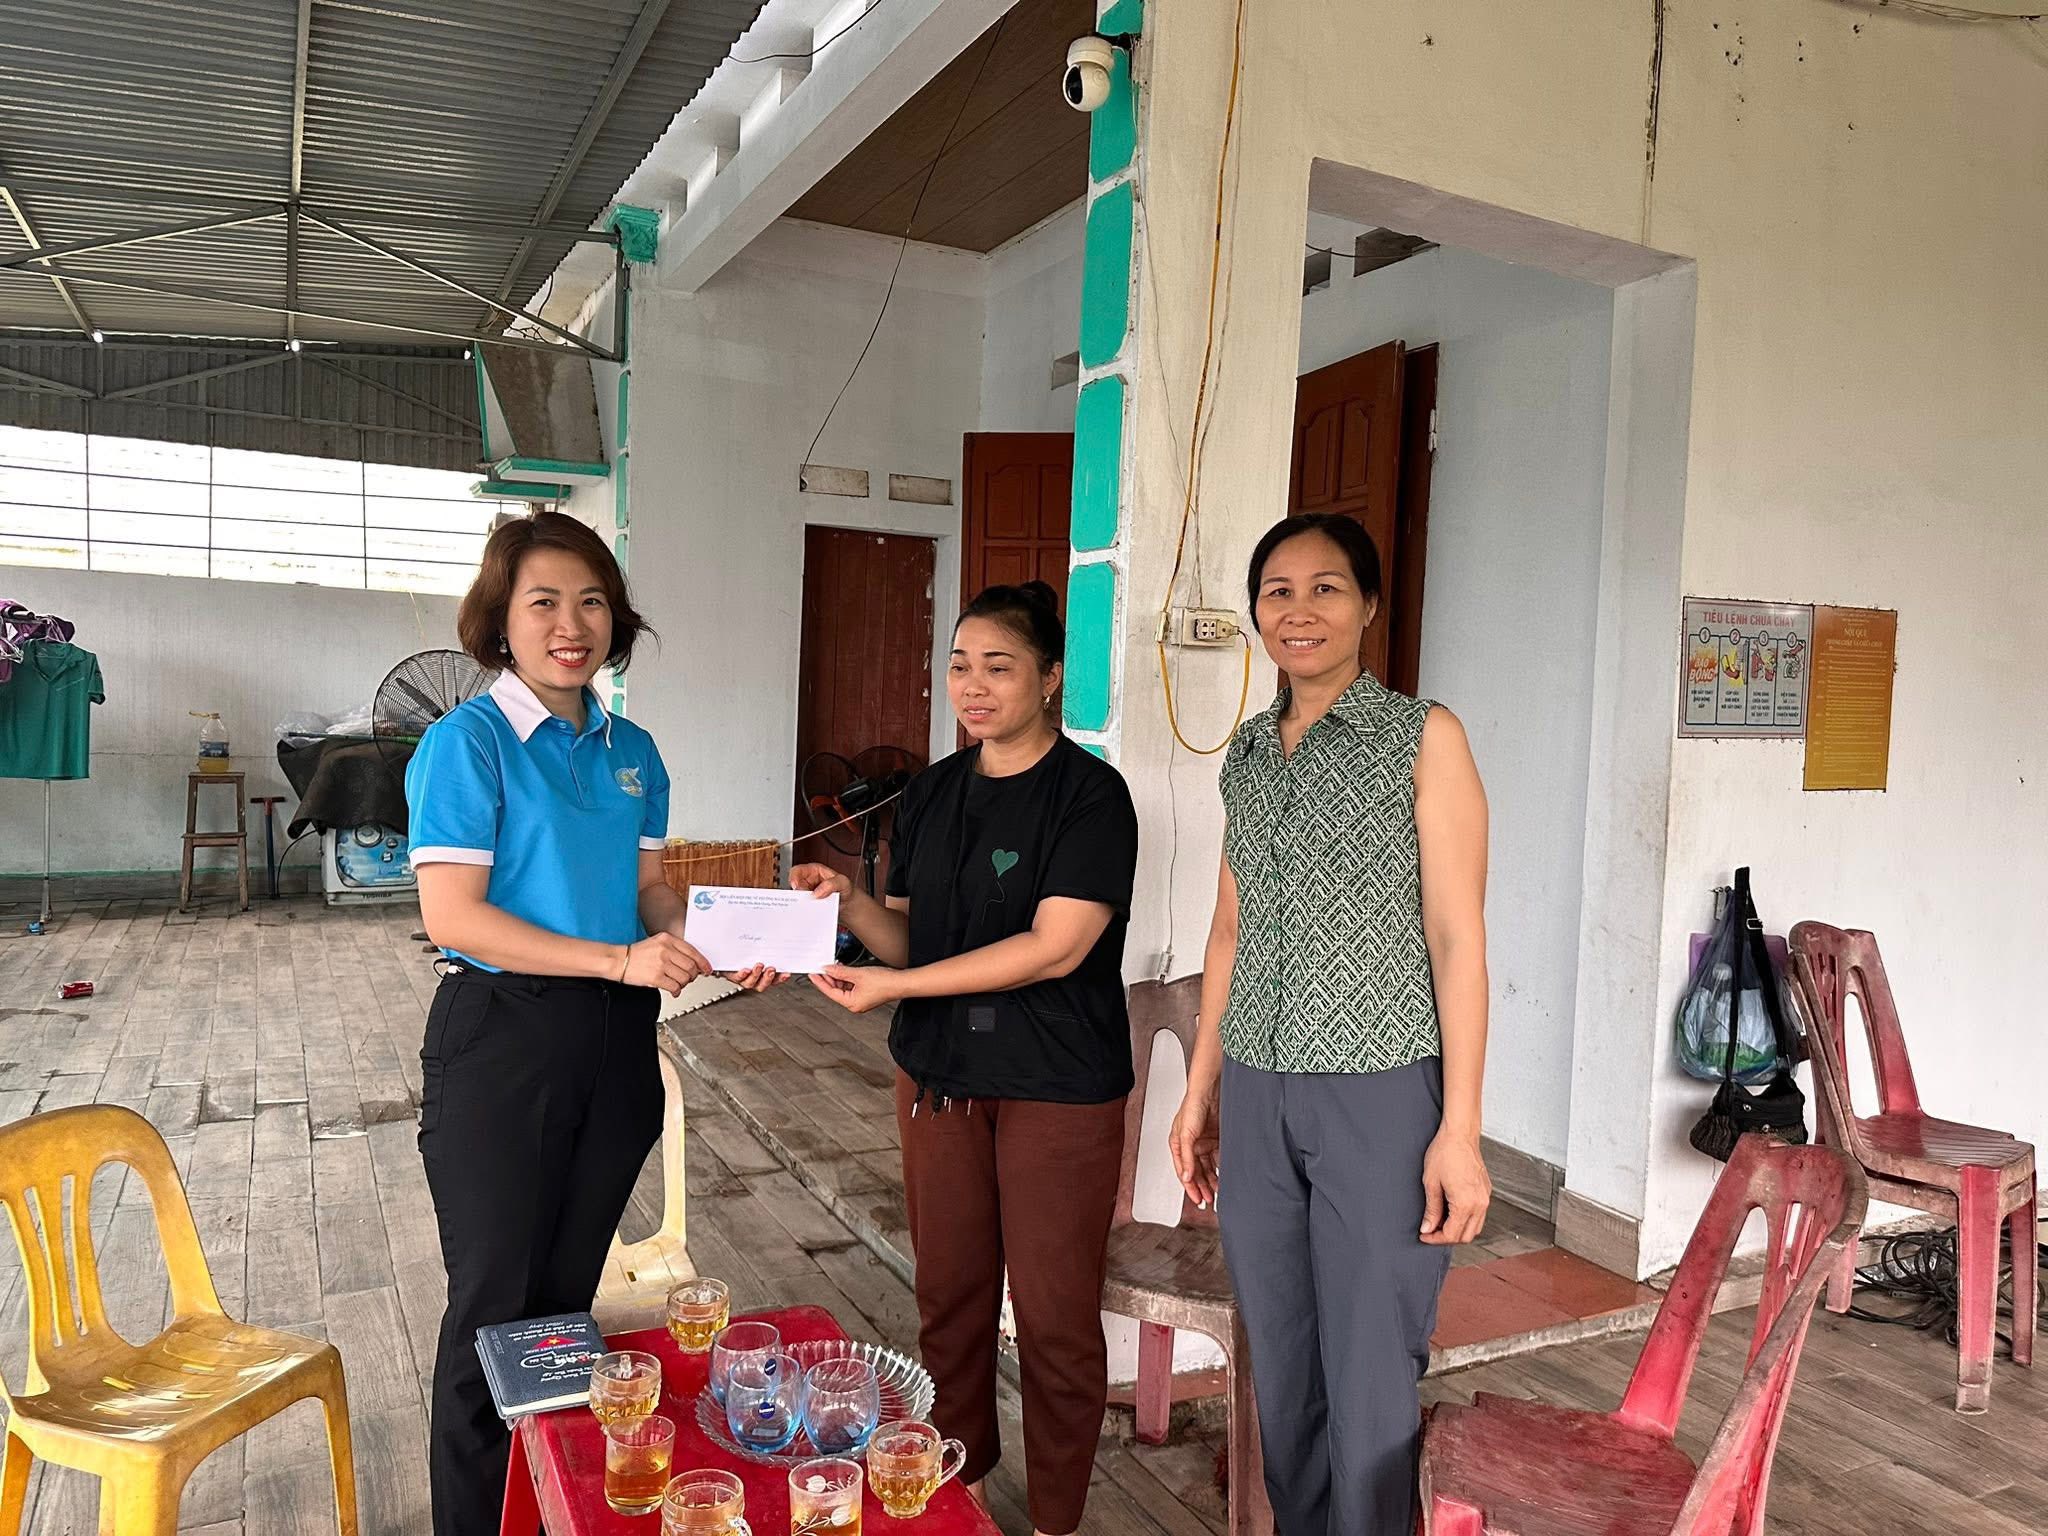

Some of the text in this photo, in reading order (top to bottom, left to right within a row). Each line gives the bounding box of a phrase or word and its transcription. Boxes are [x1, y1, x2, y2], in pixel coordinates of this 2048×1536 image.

[1732, 631, 1738, 642] 2
[1761, 633, 1767, 644] 3
[1788, 634, 1795, 645] 4
